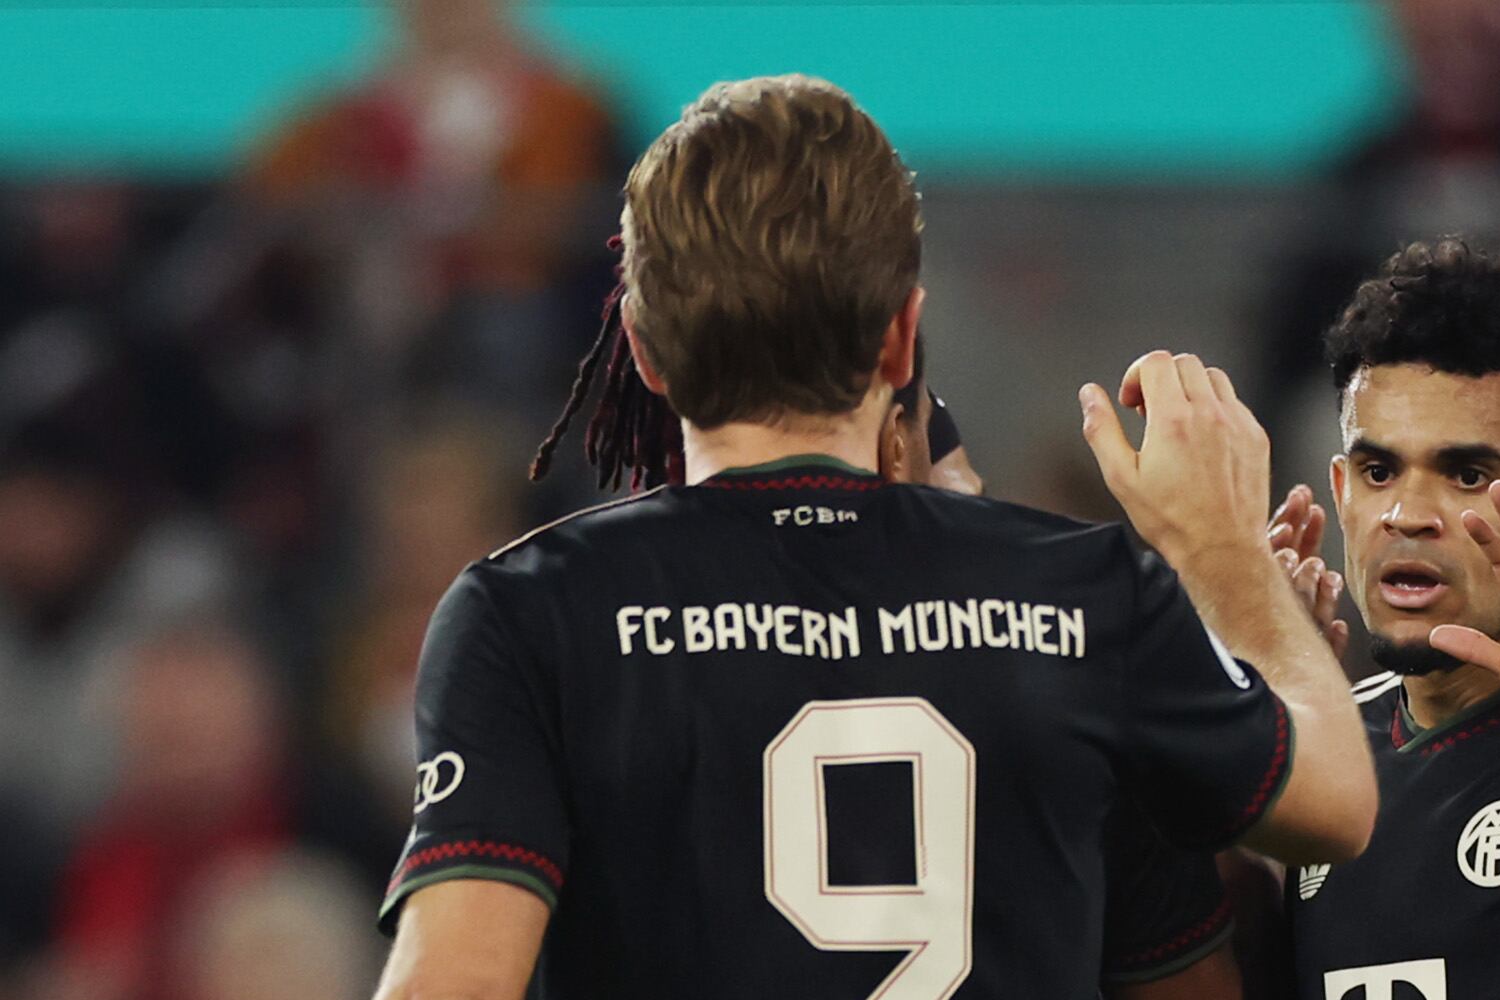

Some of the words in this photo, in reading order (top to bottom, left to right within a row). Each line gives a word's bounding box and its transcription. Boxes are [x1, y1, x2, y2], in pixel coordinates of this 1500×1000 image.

[616, 605, 675, 655] FC
[682, 602, 861, 660] BAYERN
[877, 598, 1085, 658] MÜNCHEN
